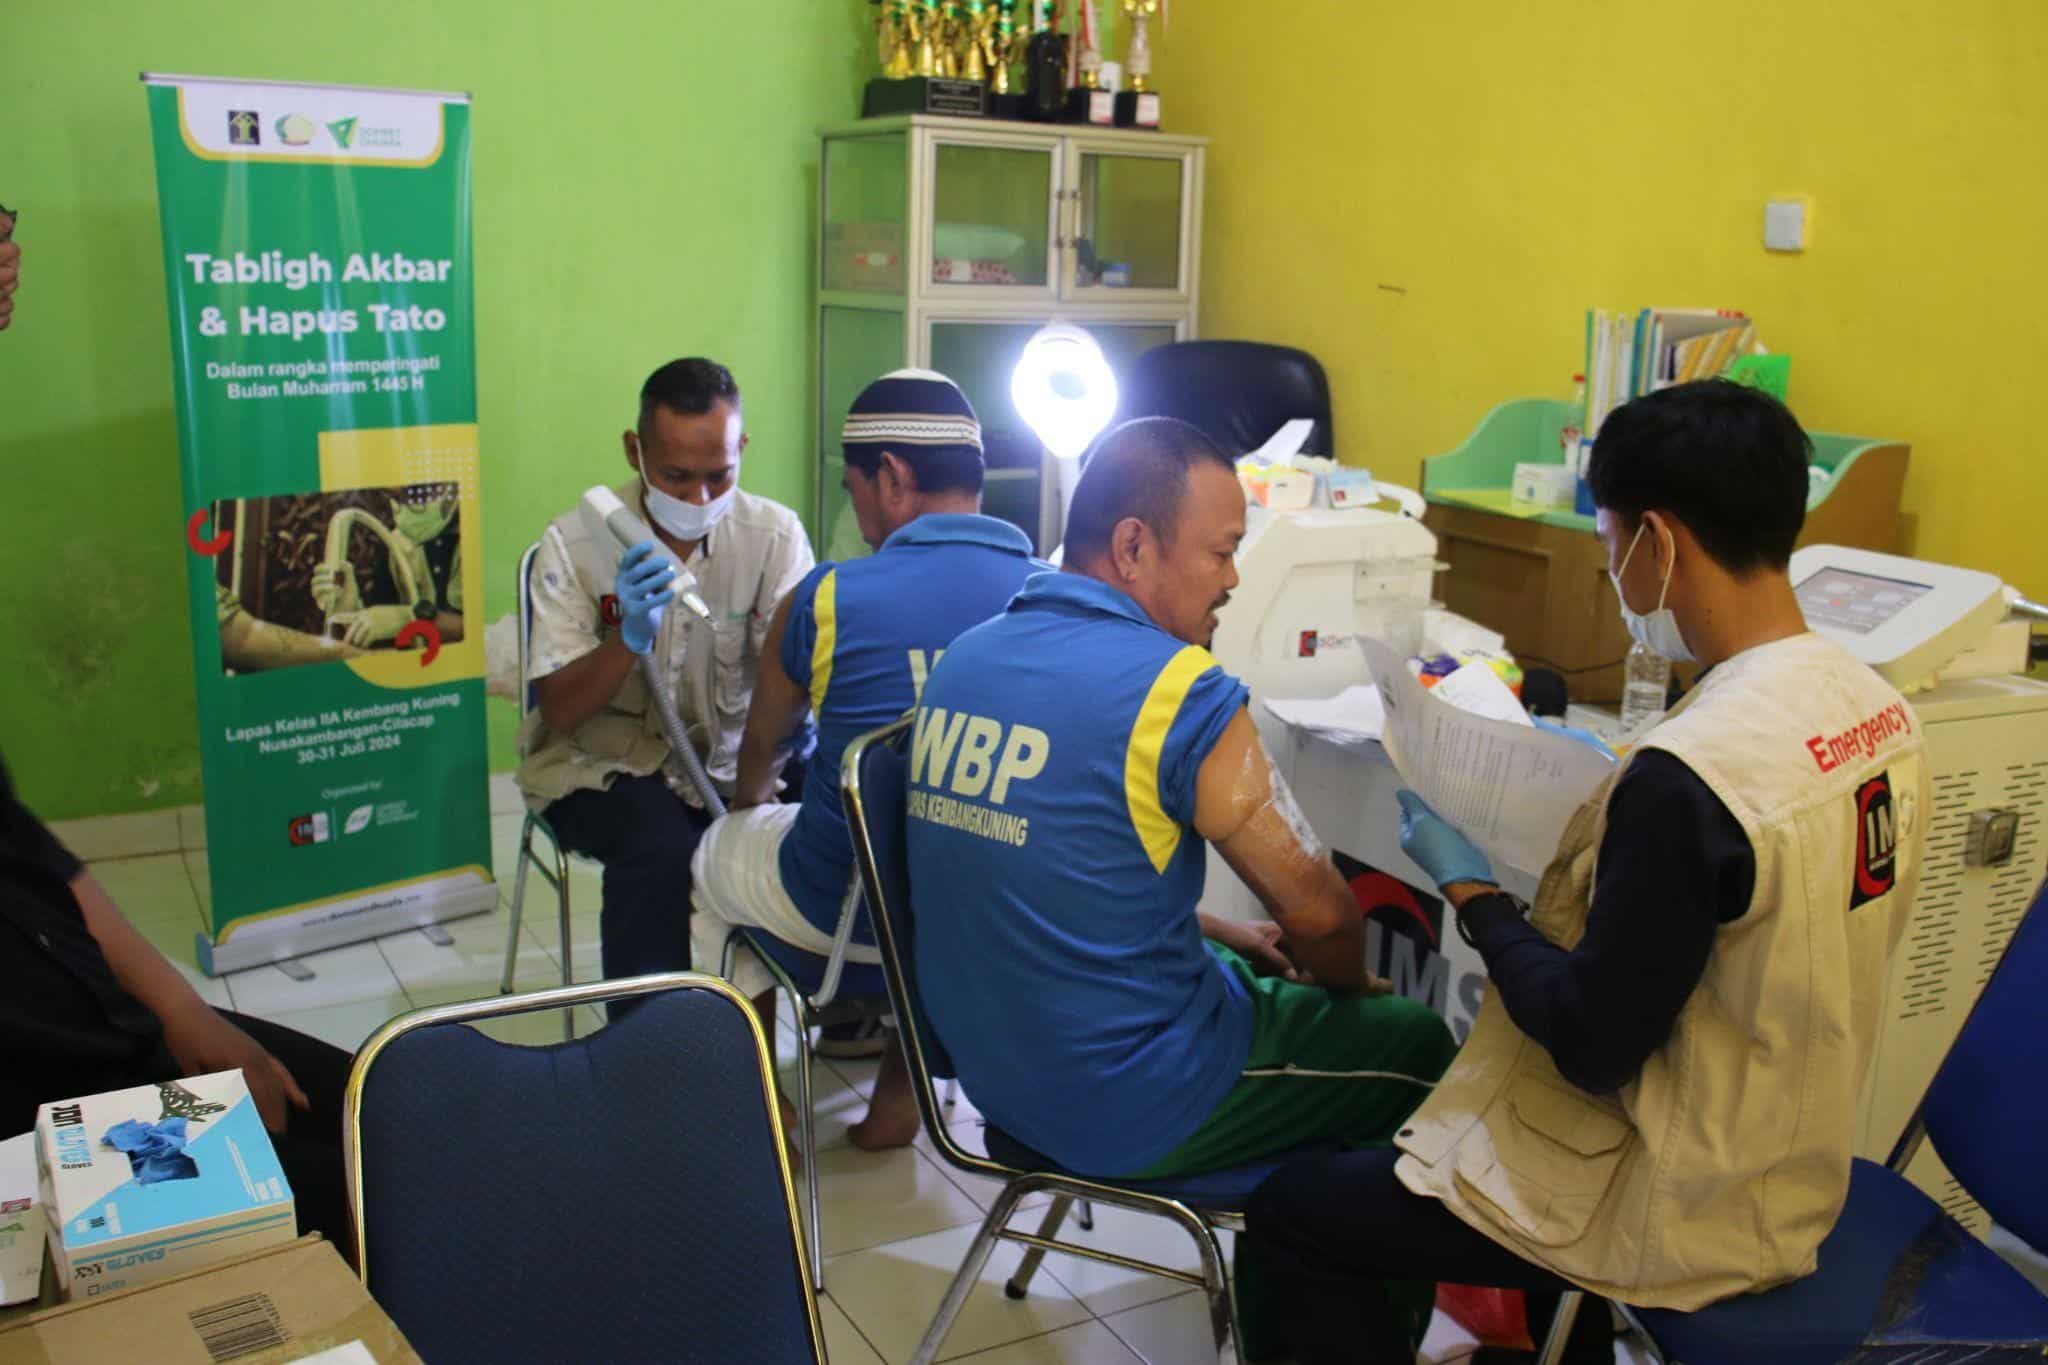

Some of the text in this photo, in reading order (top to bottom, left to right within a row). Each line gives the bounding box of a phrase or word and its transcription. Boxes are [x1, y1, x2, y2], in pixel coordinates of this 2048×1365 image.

[185, 251, 452, 290] Tabligh Akbar
[199, 303, 446, 341] & Hapus Tato
[206, 355, 441, 379] Dalam rangka memperingati
[227, 382, 278, 399] Bulan
[283, 379, 367, 397] Muharram
[412, 375, 424, 391] H
[226, 725, 271, 743] Lapas
[275, 716, 316, 734] Kelas
[343, 700, 409, 722] Kembang
[412, 692, 461, 710] Kuning
[339, 740, 365, 757] Juli
[368, 734, 401, 751] 2024
[911, 706, 1049, 805] WBP
[1806, 702, 1912, 773] Emergency
